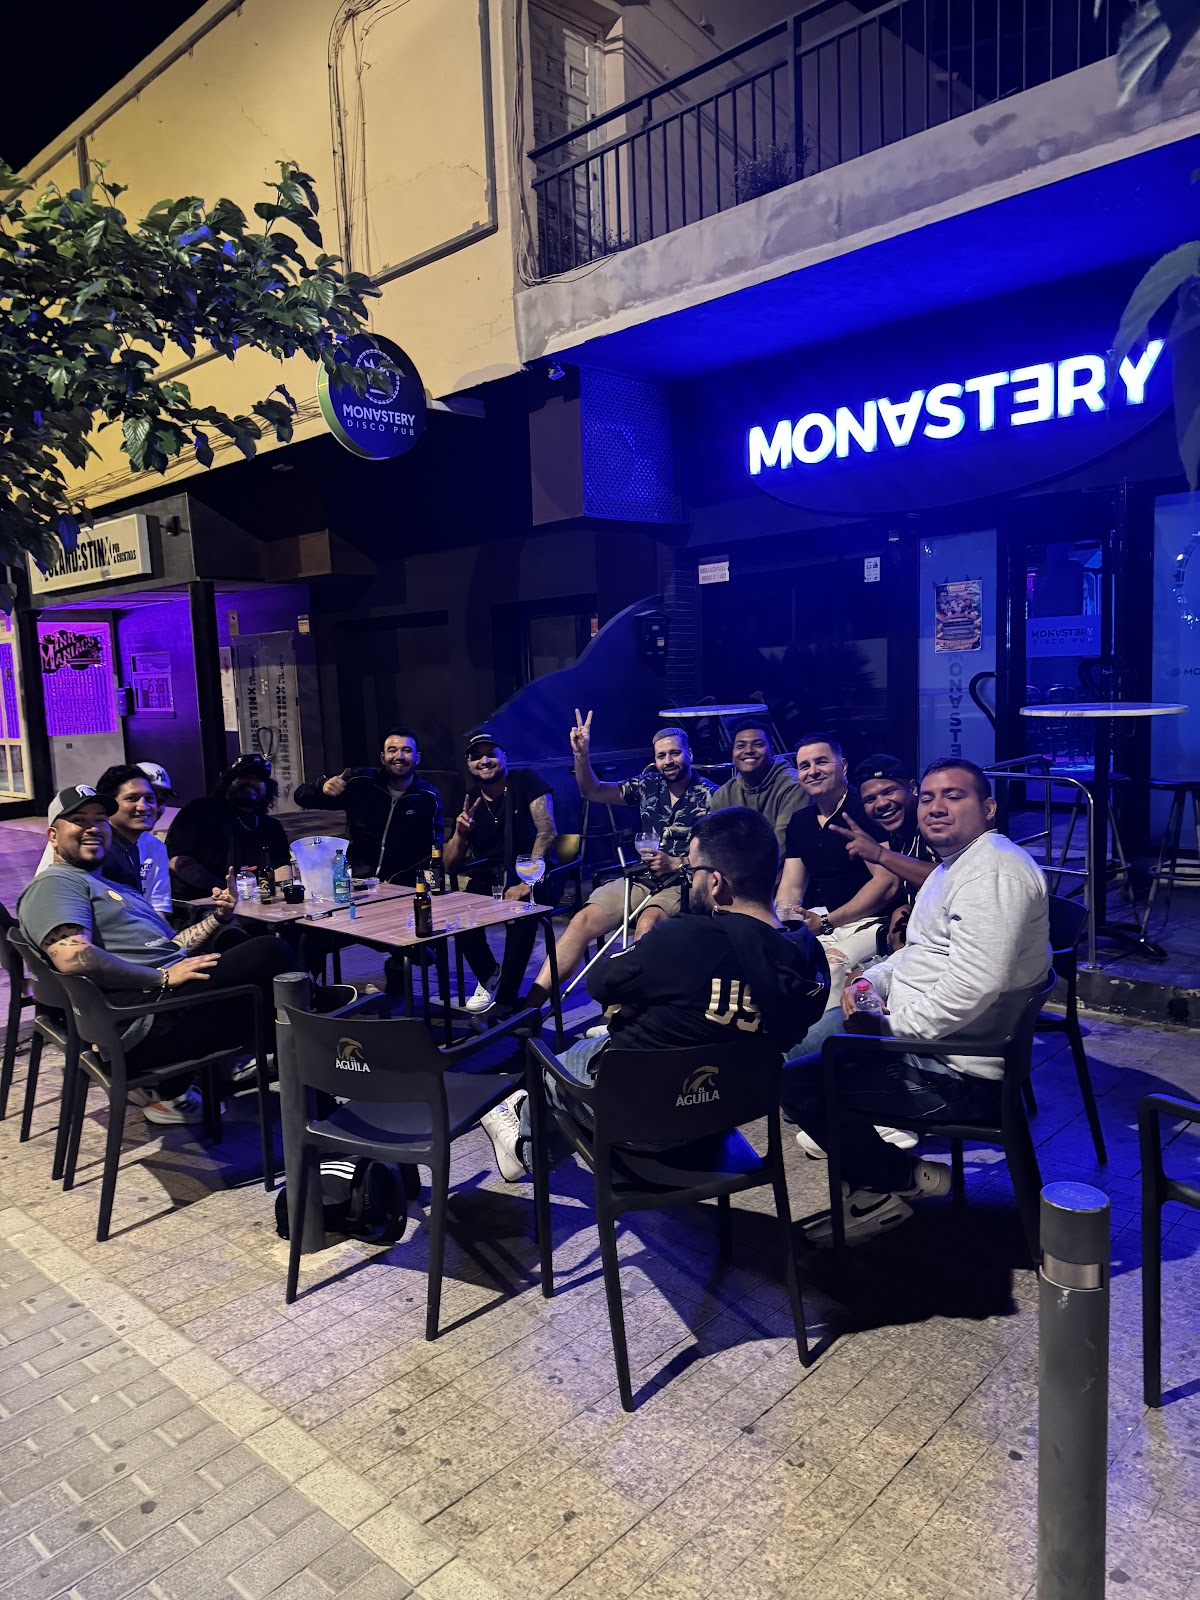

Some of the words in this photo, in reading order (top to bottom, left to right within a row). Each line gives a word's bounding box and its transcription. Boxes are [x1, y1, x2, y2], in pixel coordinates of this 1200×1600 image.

[347, 420, 385, 431] DISCO
[393, 426, 415, 436] PUB
[112, 542, 120, 553] PUB
[53, 631, 77, 651] INK
[705, 978, 762, 1033] US
